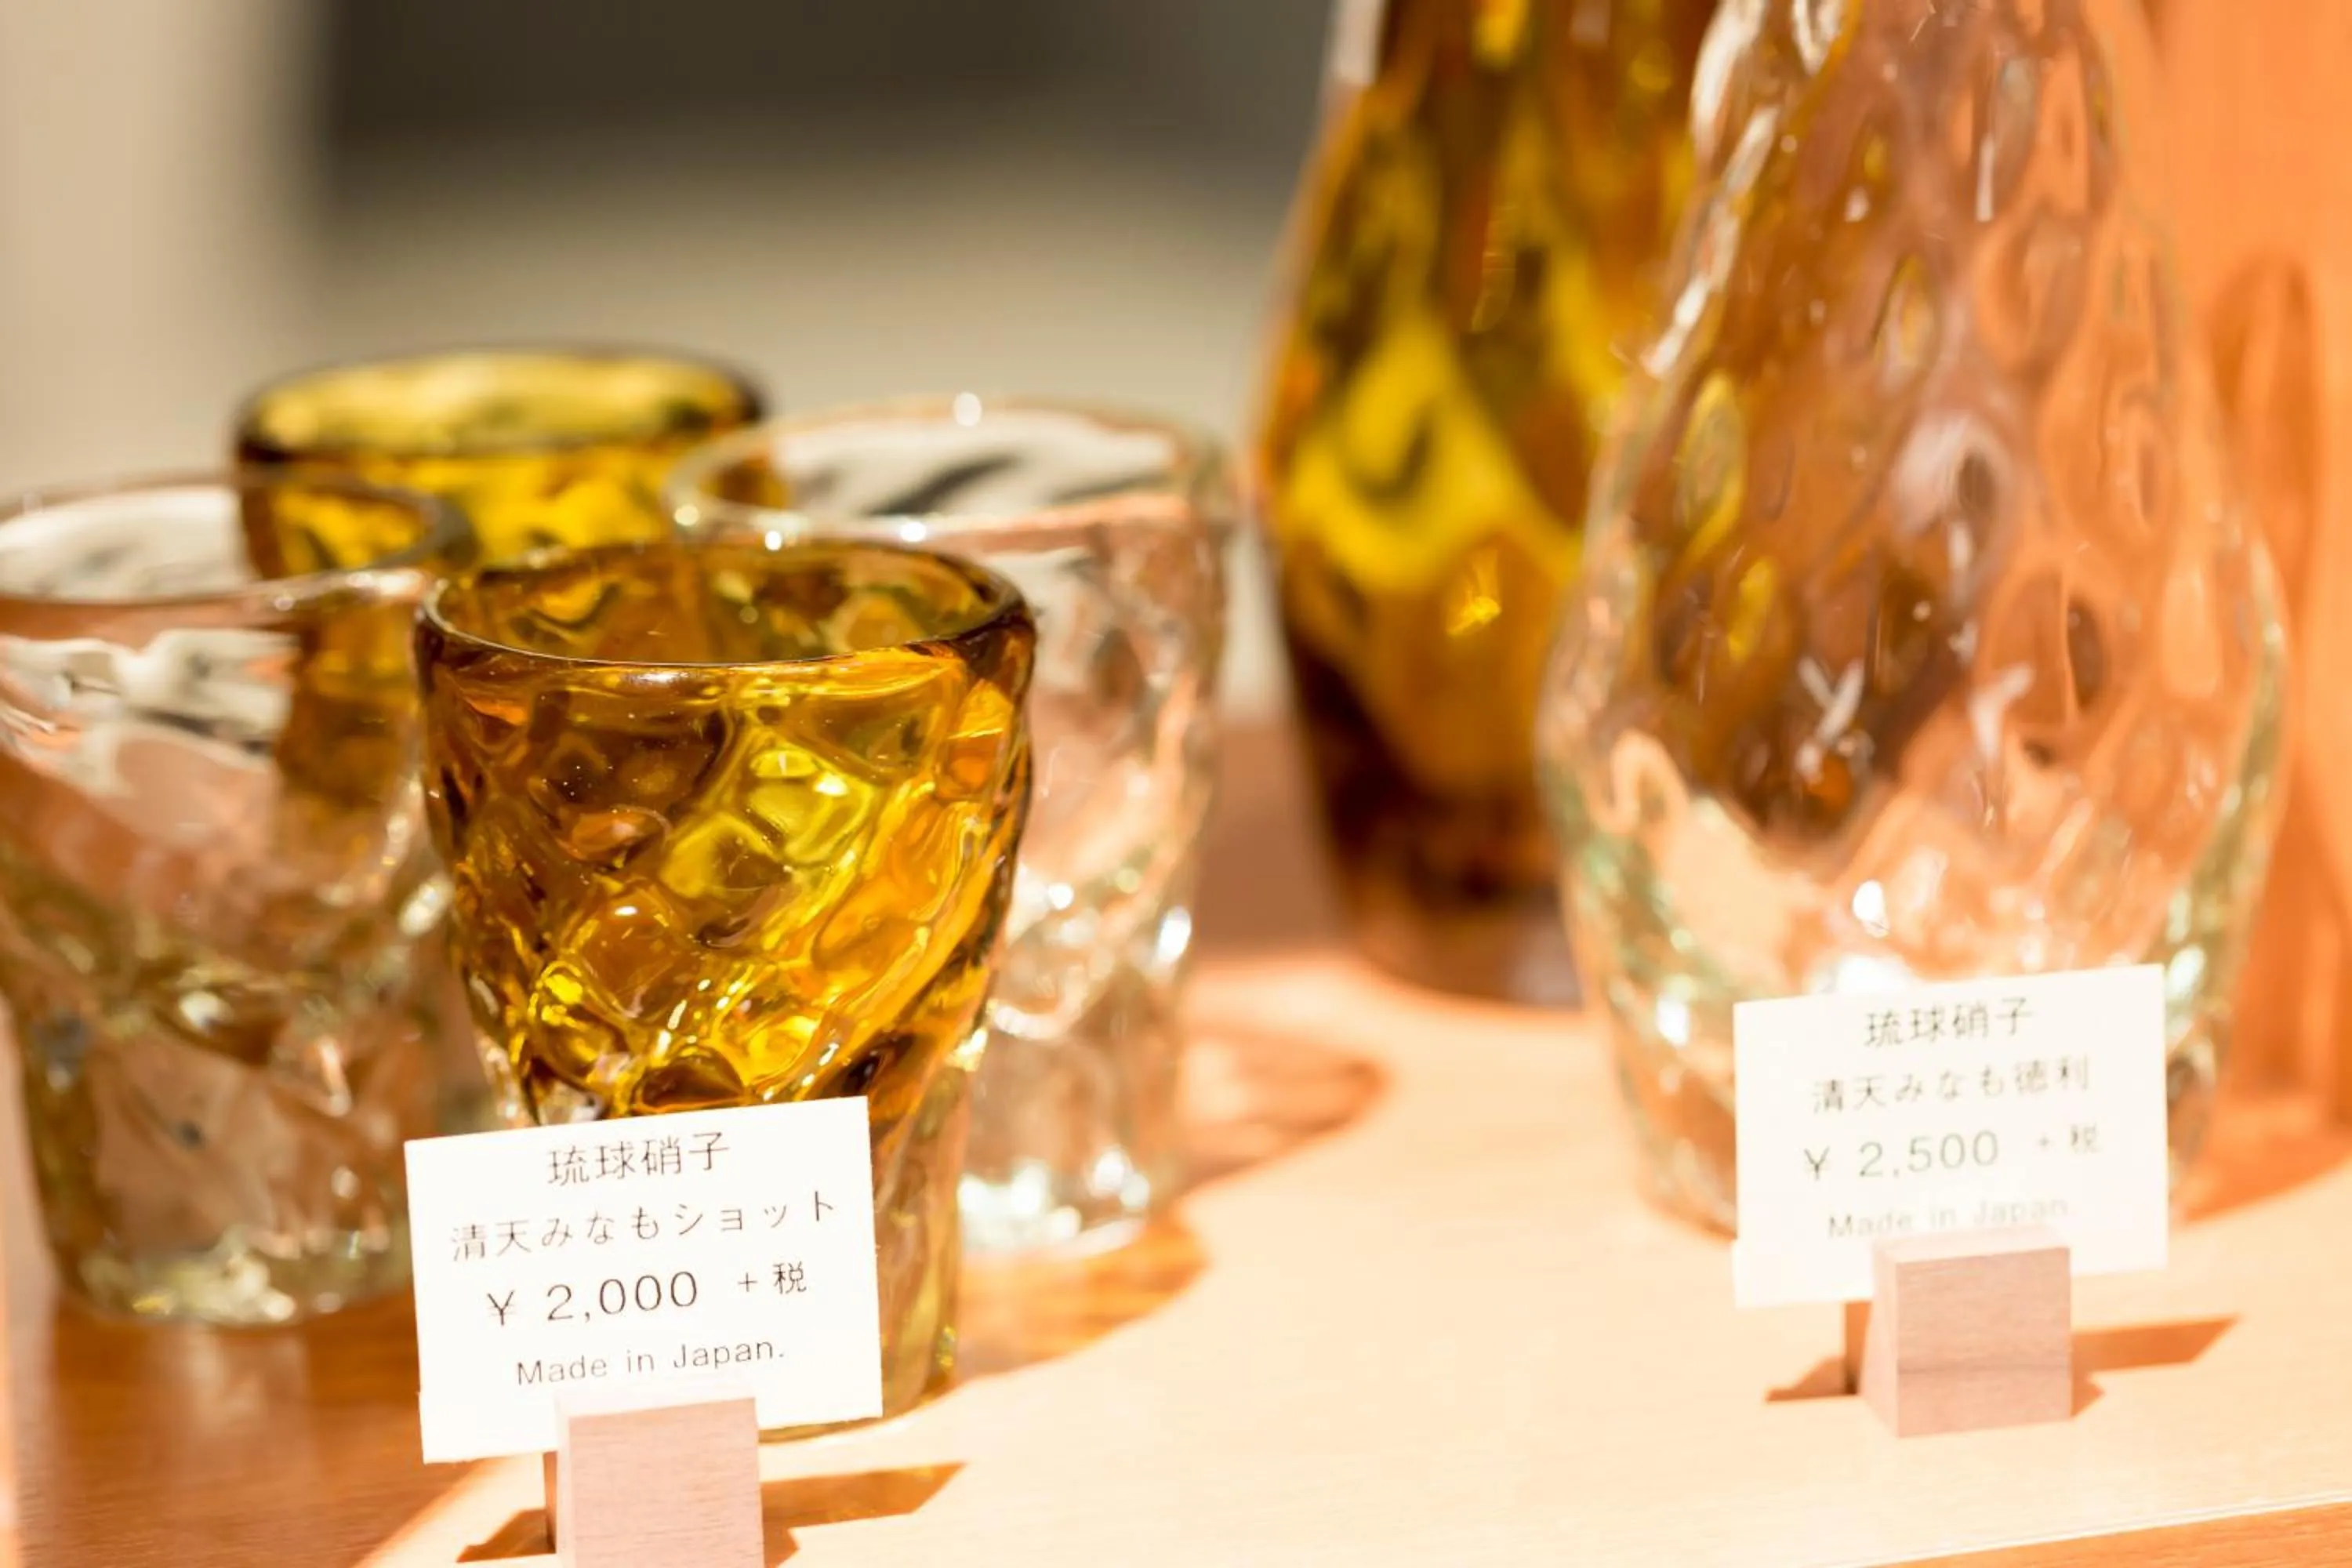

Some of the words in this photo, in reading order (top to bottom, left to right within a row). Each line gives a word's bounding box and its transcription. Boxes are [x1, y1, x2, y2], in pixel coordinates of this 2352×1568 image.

[1864, 997, 2032, 1048] 琉球硝子
[547, 1132, 730, 1187] 琉球硝子
[452, 1191, 834, 1262] 清天みなもショット
[1828, 1211, 1913, 1239] Made
[1930, 1205, 1957, 1229] in
[516, 1355, 608, 1386] Made
[627, 1349, 655, 1374] in
[673, 1341, 784, 1370] Japan.
